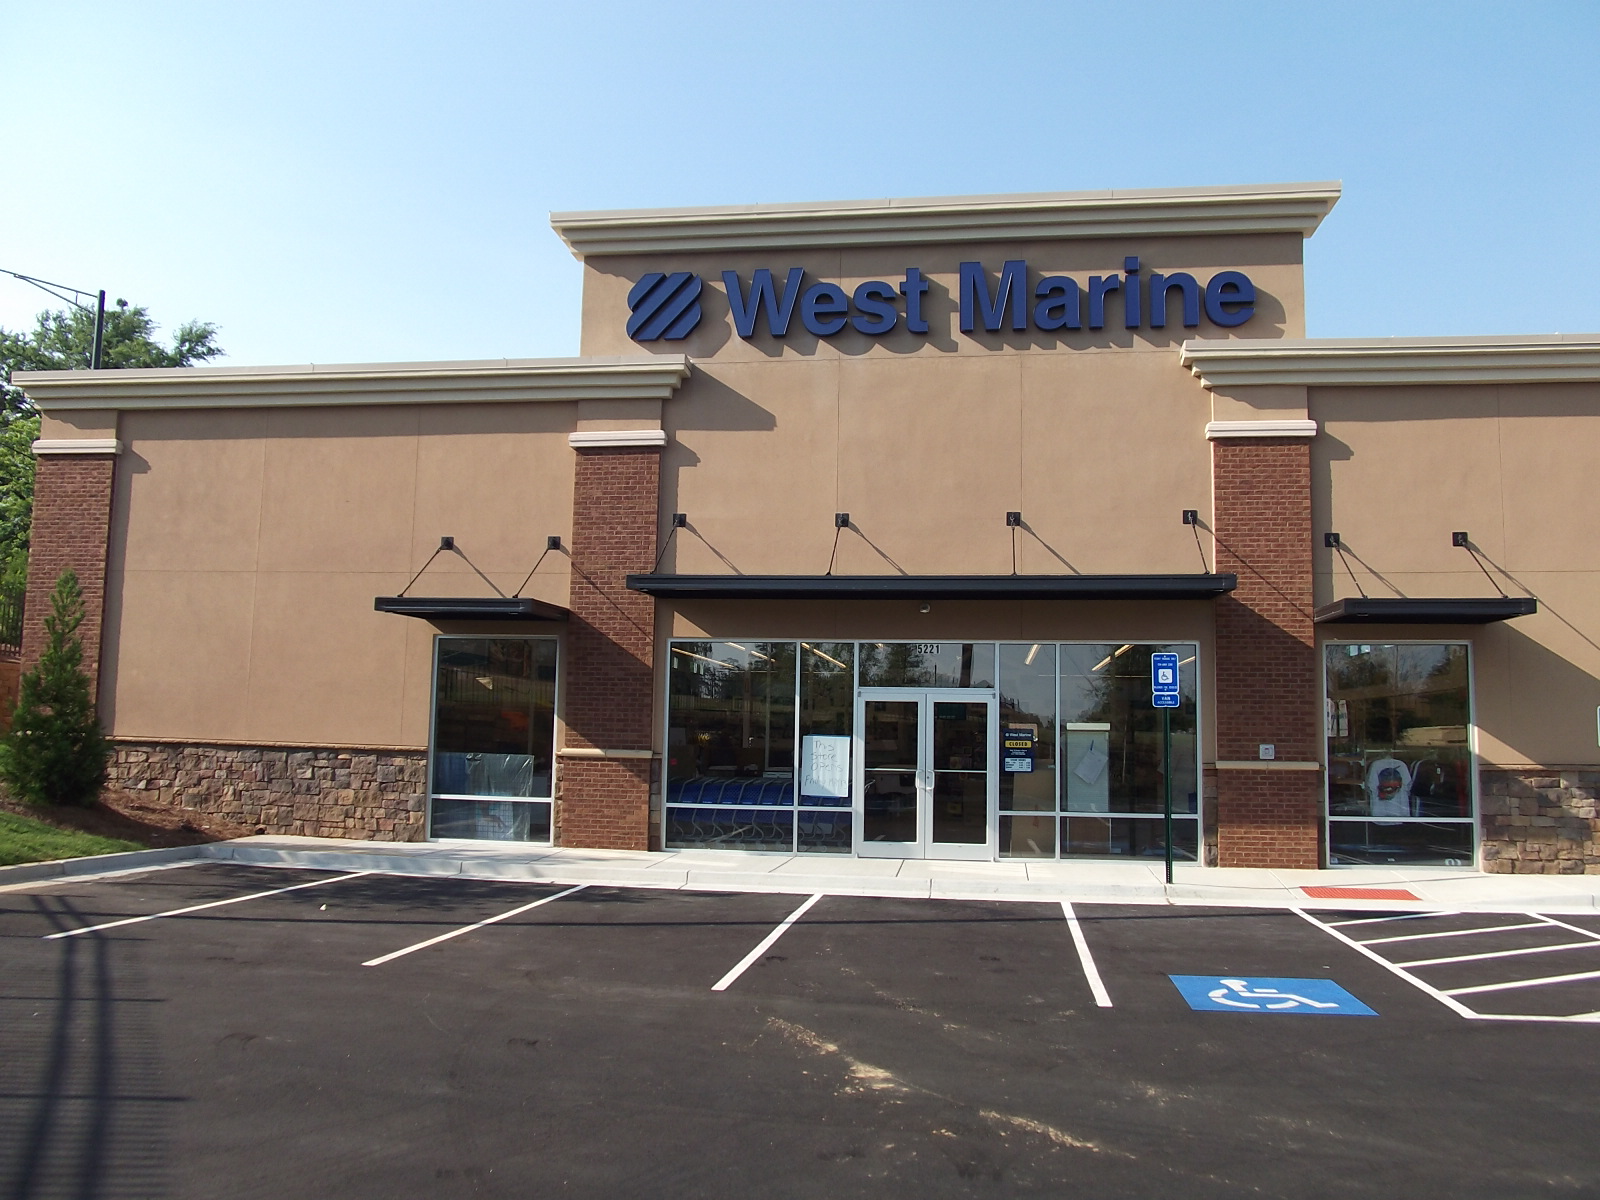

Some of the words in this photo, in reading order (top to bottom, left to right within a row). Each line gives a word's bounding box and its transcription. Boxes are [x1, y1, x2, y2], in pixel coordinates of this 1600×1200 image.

[721, 266, 929, 340] West
[959, 255, 1257, 333] Marine
[918, 644, 940, 654] 5221
[813, 740, 835, 751] This
